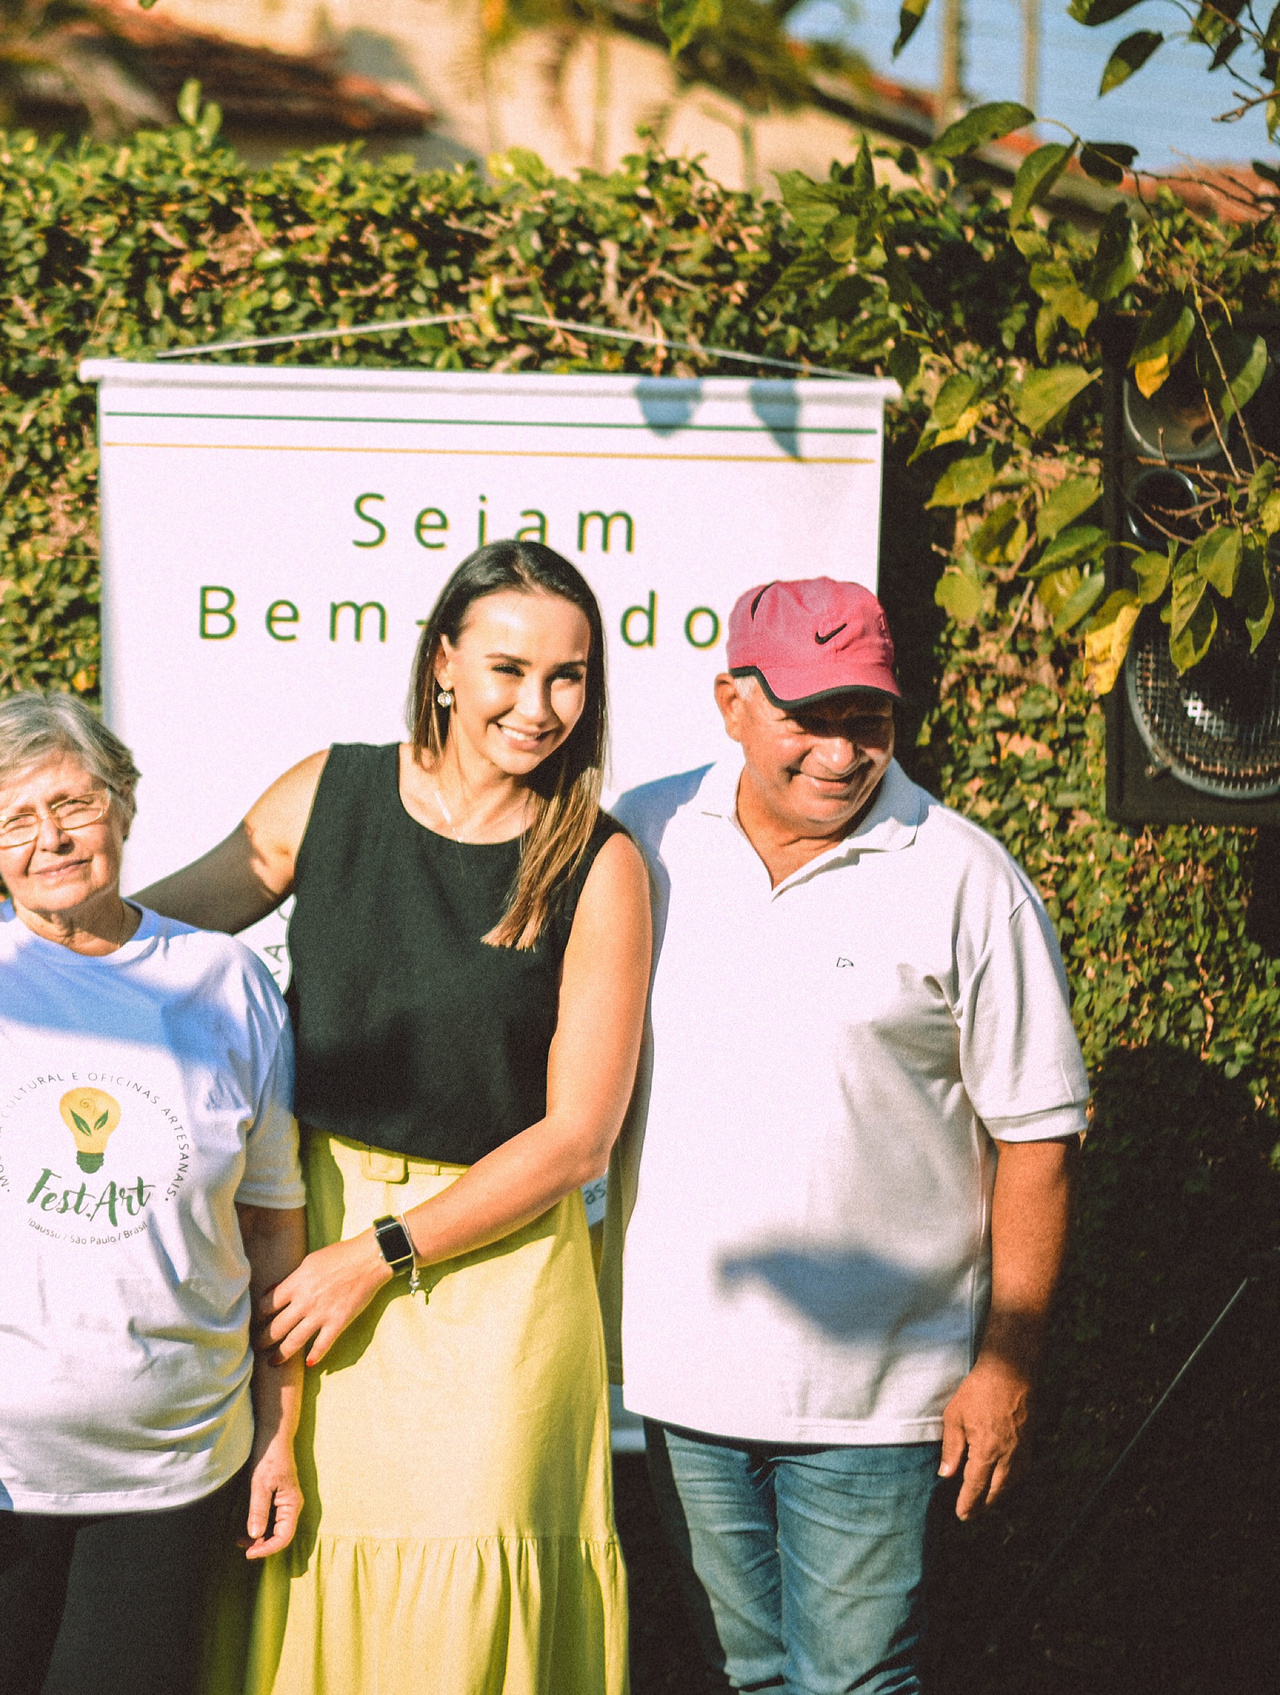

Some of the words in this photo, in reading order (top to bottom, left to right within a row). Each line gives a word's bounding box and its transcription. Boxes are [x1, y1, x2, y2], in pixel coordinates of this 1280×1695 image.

[87, 1072, 160, 1104] OFICINAS
[90, 1233, 116, 1245] Paulo
[124, 1221, 148, 1239] Brasil
